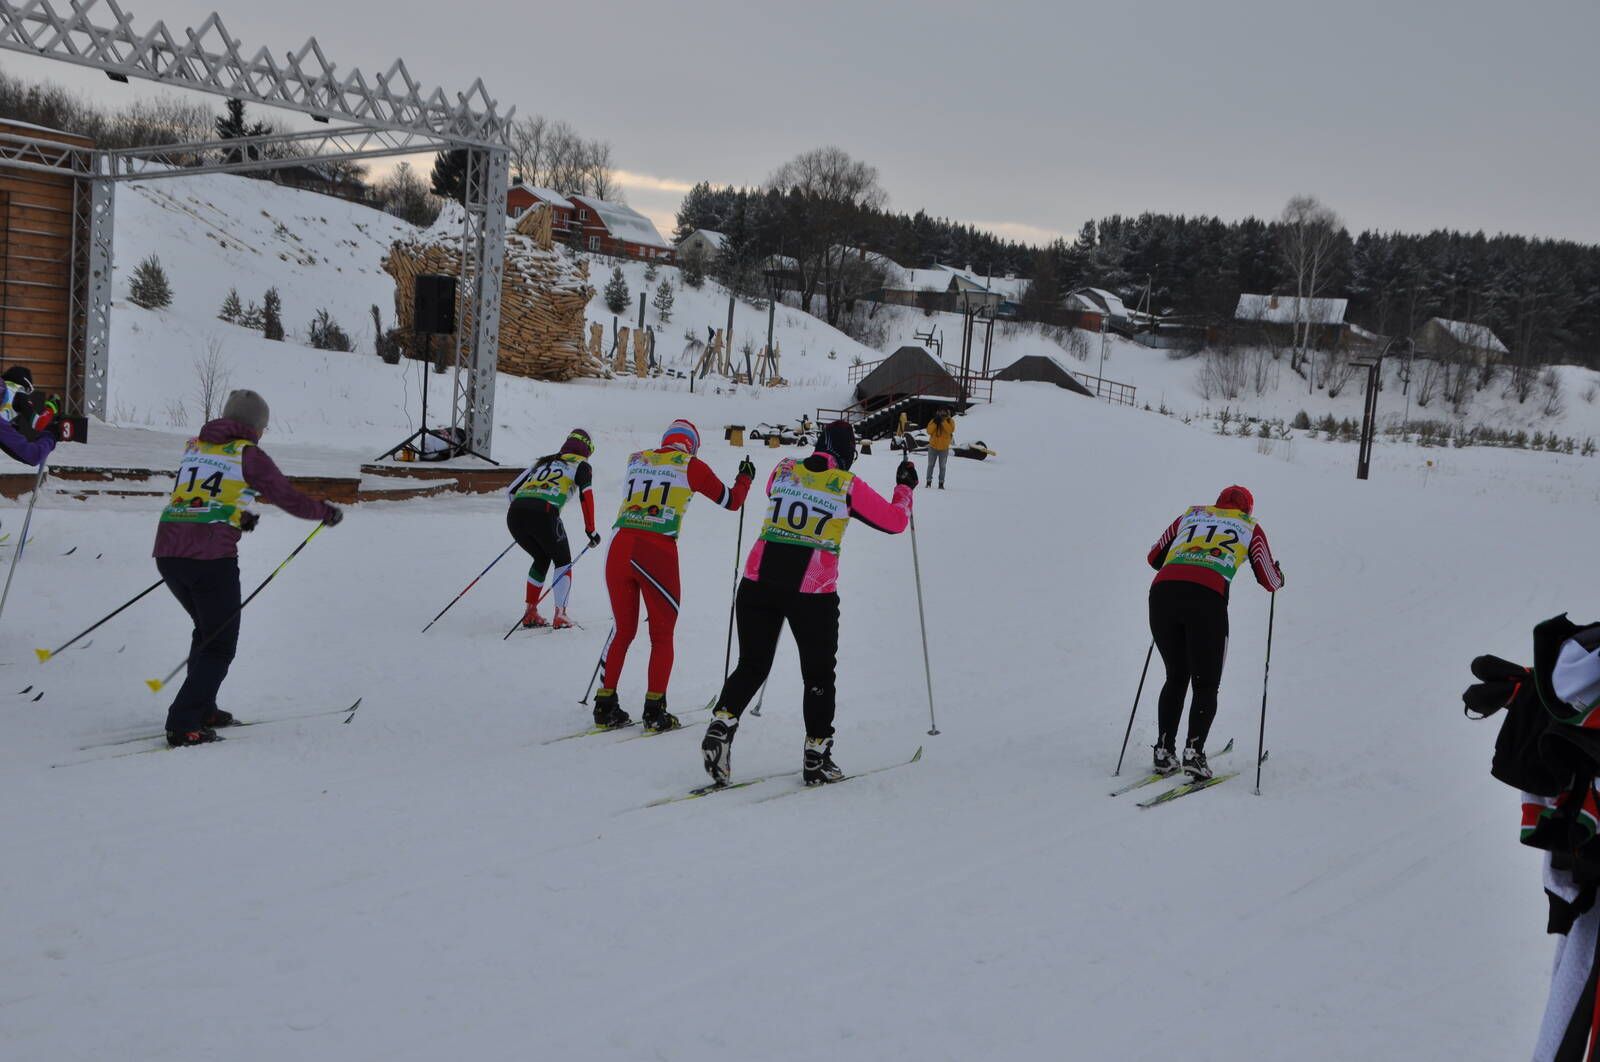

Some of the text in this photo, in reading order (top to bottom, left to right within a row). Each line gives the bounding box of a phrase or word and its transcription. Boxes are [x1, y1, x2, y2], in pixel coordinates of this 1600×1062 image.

[63, 422, 70, 438] 3
[627, 478, 671, 505] 111
[802, 492, 838, 511] САБАСЫ
[770, 497, 833, 536] 107
[1186, 524, 1239, 553] 112
